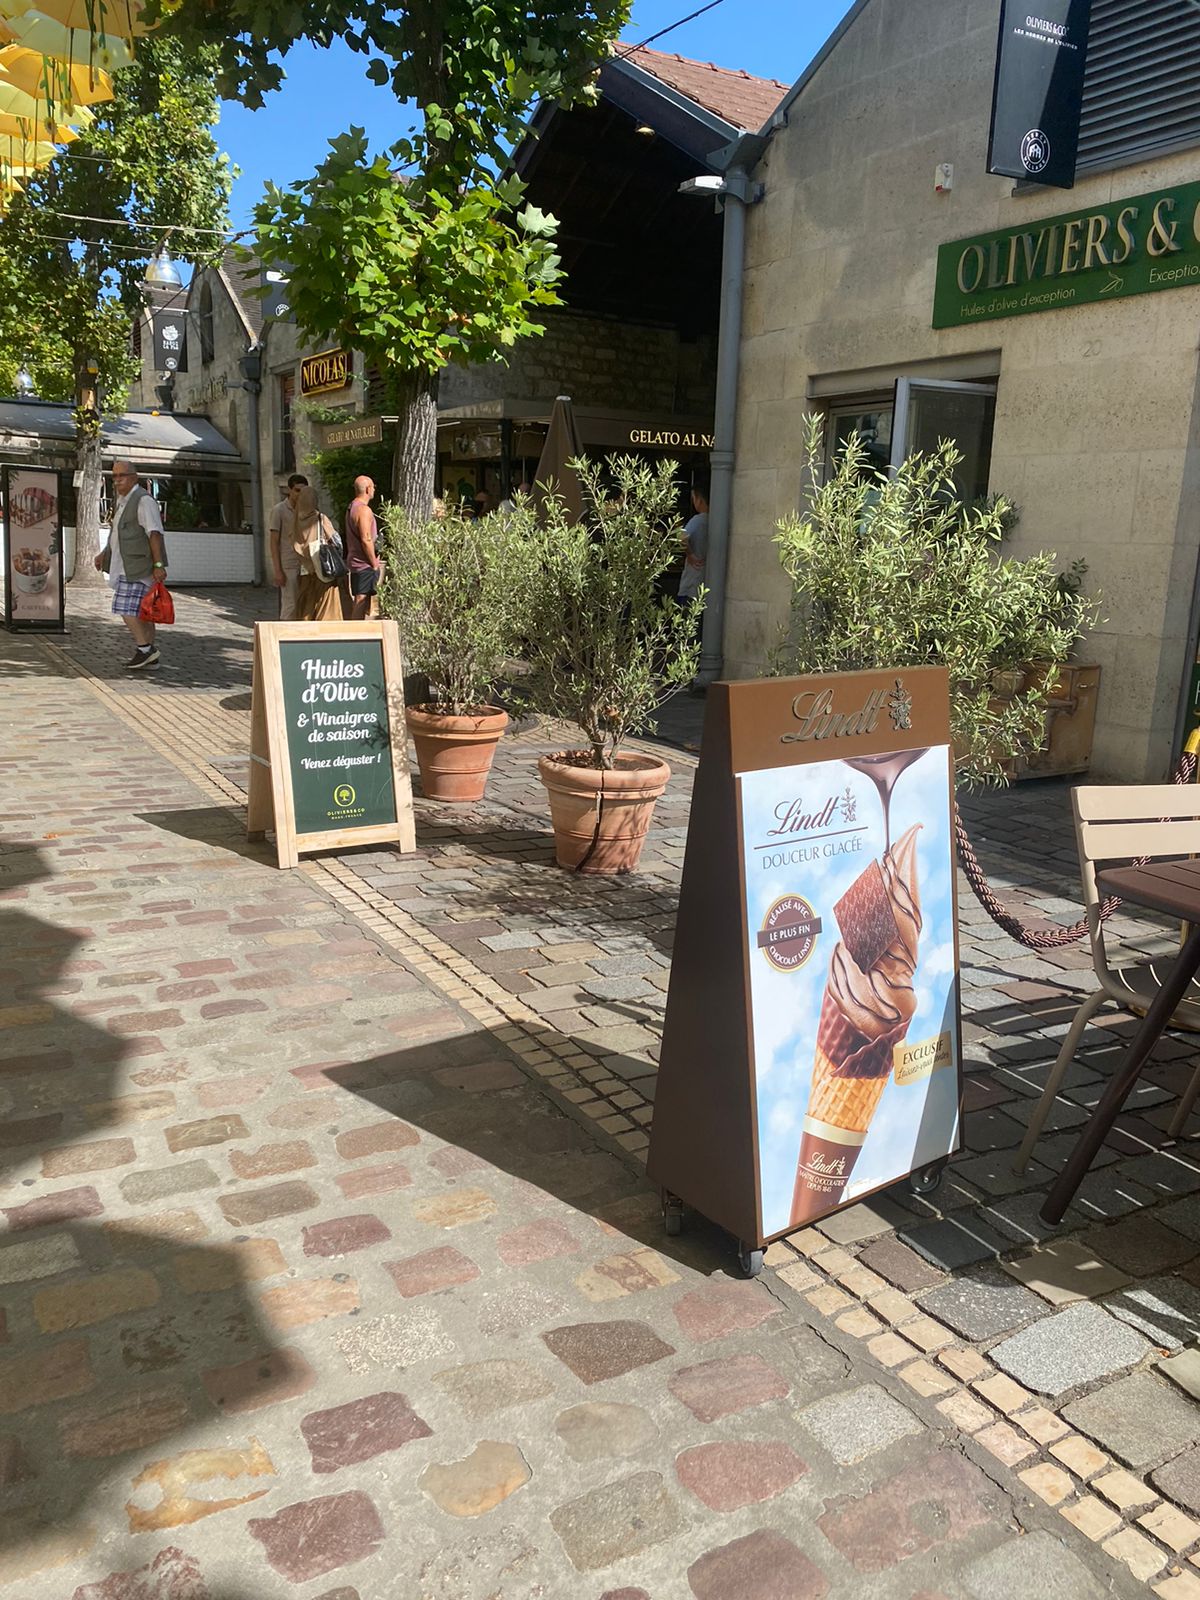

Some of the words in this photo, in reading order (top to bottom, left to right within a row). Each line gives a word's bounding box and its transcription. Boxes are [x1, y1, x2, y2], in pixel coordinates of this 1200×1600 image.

[957, 206, 1139, 294] OLIVIERS
[1147, 198, 1182, 256] &
[1149, 264, 1200, 284] Exceptio
[988, 297, 1018, 313] d'olive
[1021, 287, 1075, 306] d'exception
[303, 354, 345, 388] NICOLAS
[630, 429, 680, 445] GELATO
[682, 433, 699, 447] AL
[301, 659, 364, 680] Huiles
[301, 681, 368, 703] d'Olive
[297, 713, 309, 727] &
[312, 711, 377, 728] Vinaigres
[781, 688, 887, 743] Lindt
[308, 729, 325, 743] de
[326, 727, 371, 742] saison
[301, 757, 332, 769] Venez
[333, 754, 375, 769] déguster
[767, 796, 839, 836] Lindt
[762, 846, 820, 869] DOUCEUR
[823, 835, 862, 858] GLACÉE
[769, 900, 792, 925] RÉALISÉ
[793, 902, 809, 918] AVEC
[770, 931, 778, 941] LE
[780, 927, 797, 939] PLUS
[799, 924, 811, 935] FIN
[769, 945, 798, 965] CHOCOLAT
[798, 937, 812, 959] LINDT
[903, 1040, 944, 1065] EXCLUSIF
[806, 1151, 840, 1175] Lindt
